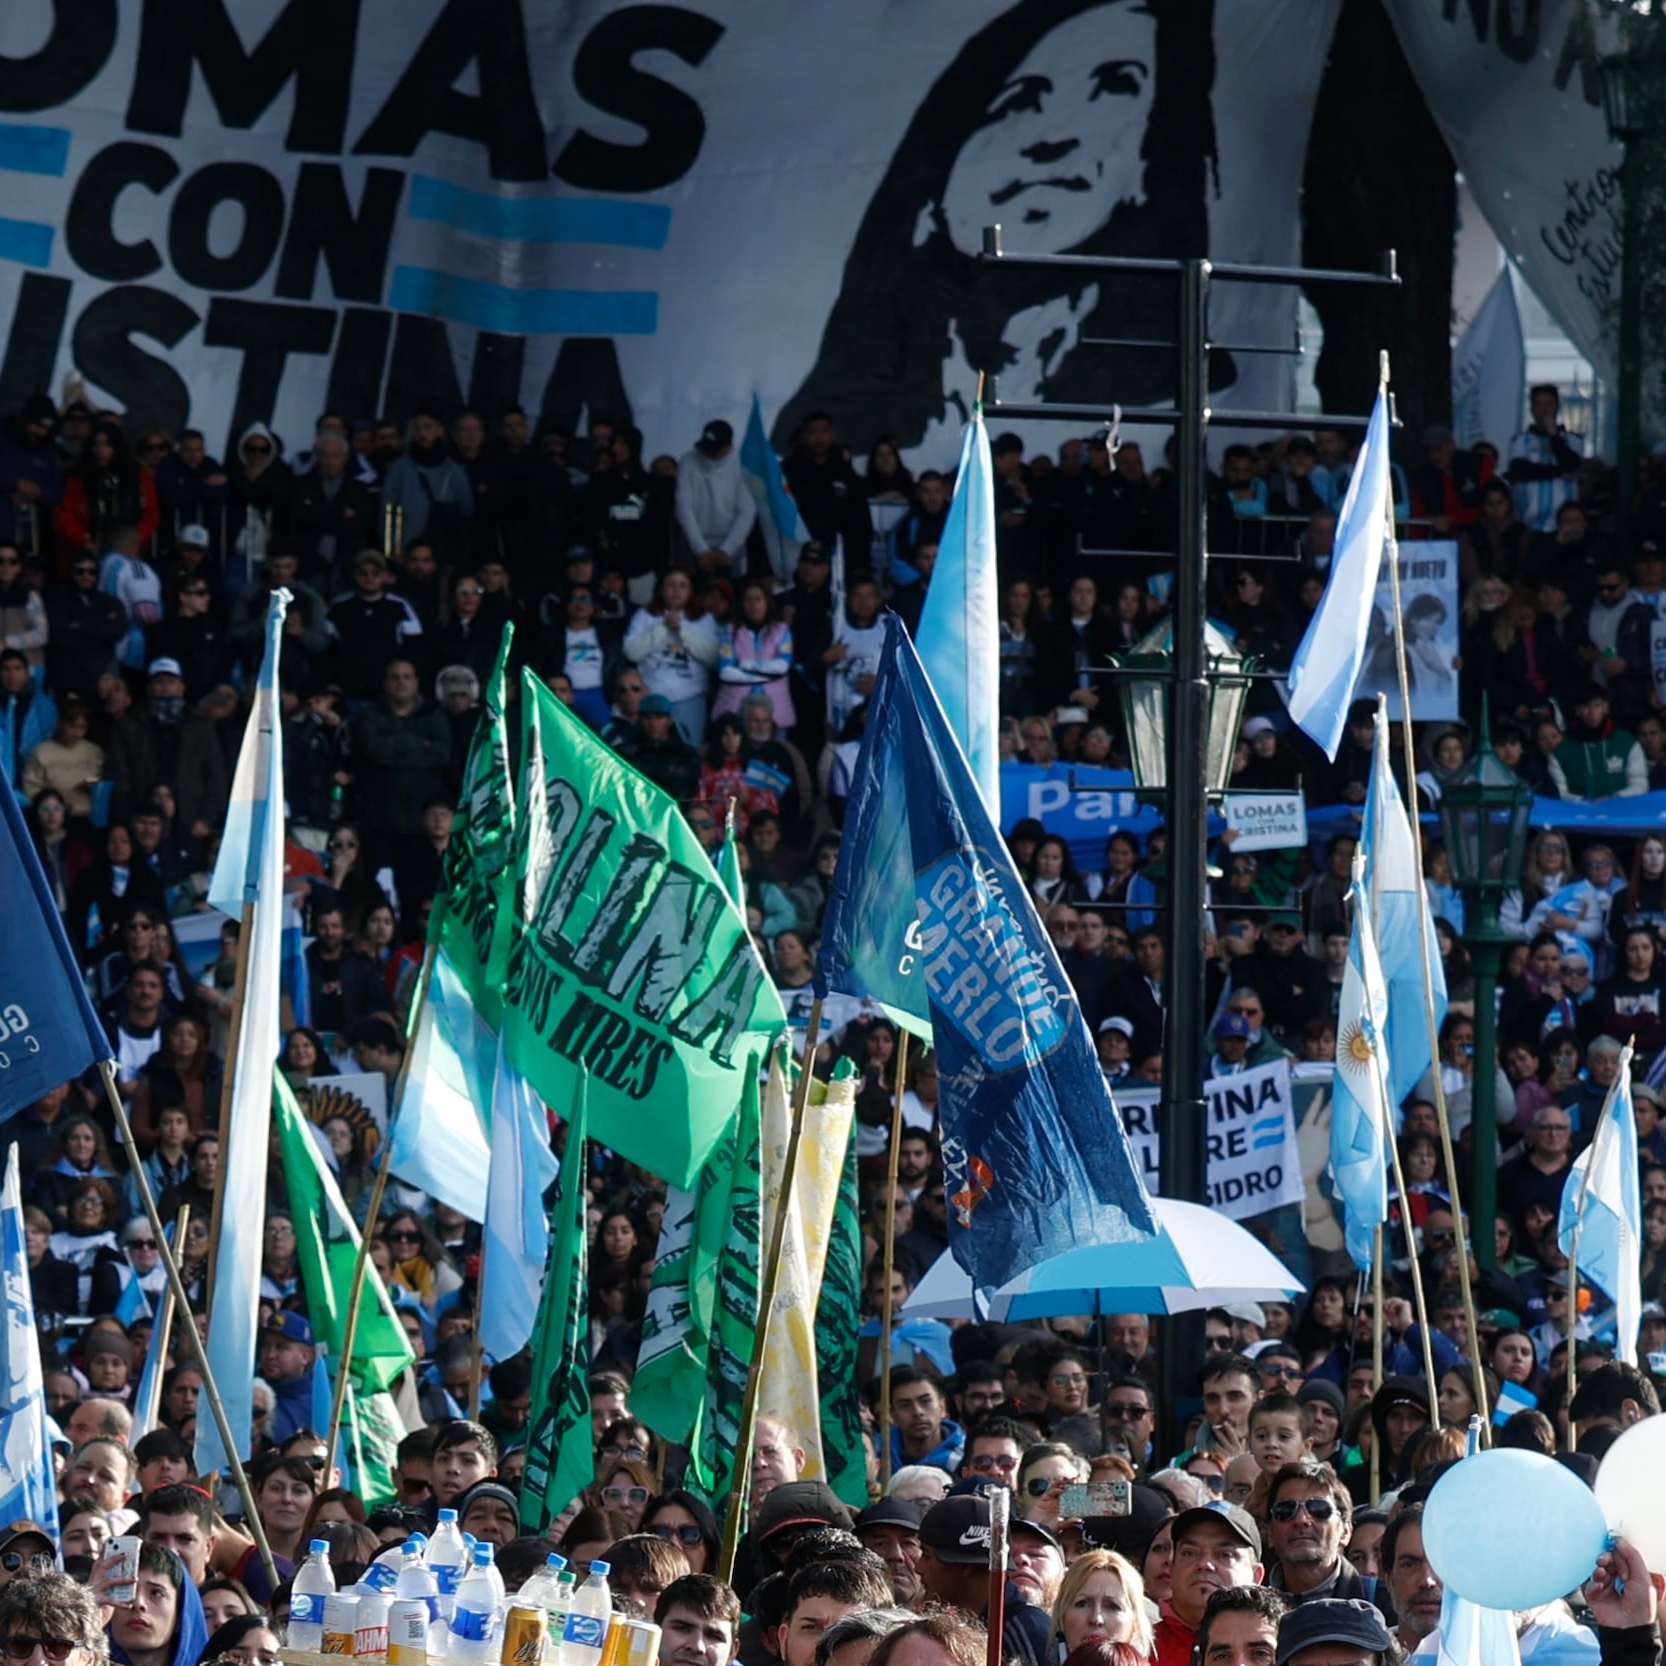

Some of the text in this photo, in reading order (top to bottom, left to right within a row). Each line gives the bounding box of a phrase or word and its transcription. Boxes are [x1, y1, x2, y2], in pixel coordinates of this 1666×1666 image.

[66, 142, 404, 306] CON
[1233, 802, 1297, 820] LOMAS
[915, 896, 1027, 1063] MERLO
[929, 862, 1061, 1037] GRANDE
[546, 991, 676, 1100] AIRES
[965, 1525, 992, 1538] NIKE
